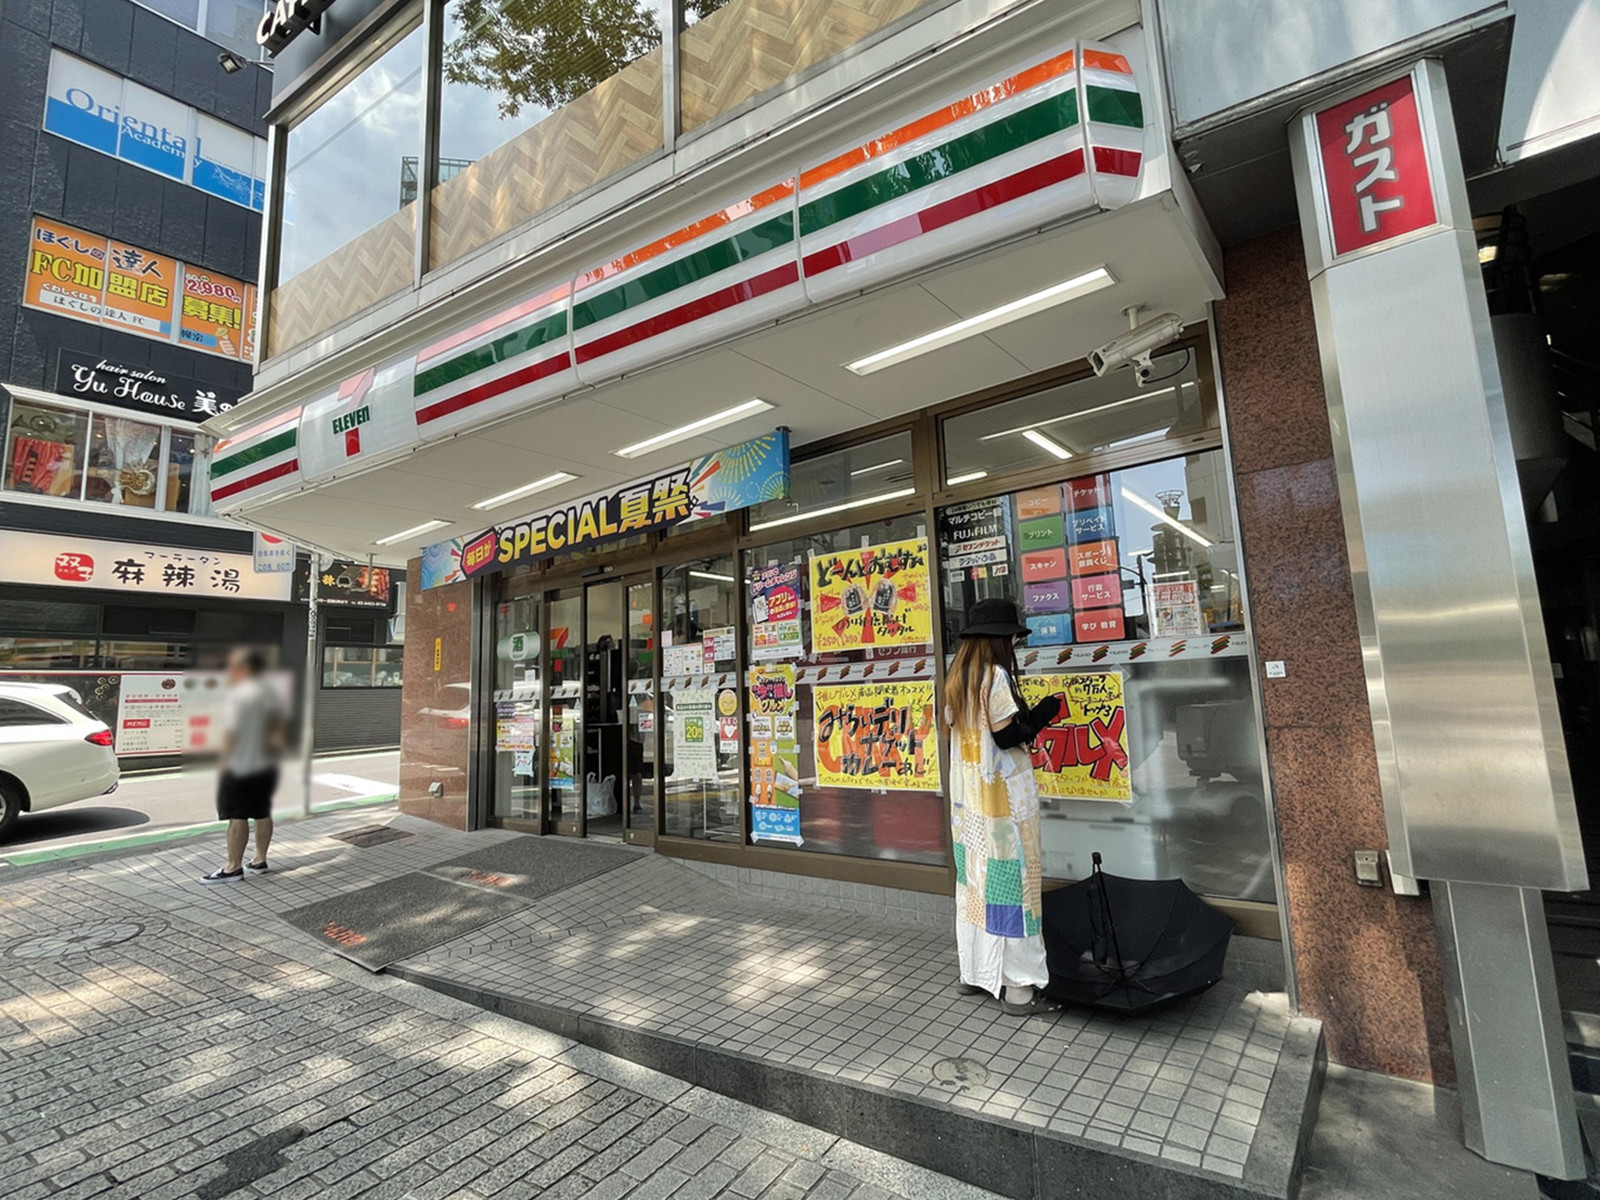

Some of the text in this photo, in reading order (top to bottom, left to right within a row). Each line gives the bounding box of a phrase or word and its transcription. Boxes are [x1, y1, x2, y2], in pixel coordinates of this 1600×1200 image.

[66, 88, 202, 158] Oriental
[121, 124, 203, 168] Academy
[1344, 101, 1402, 233] ガスト
[36, 228, 163, 279] ほぐしの達人
[31, 250, 170, 308] FC加盟店
[53, 295, 146, 326] ほぐしの達人 FC
[95, 359, 168, 385] hair salon
[947, 507, 1002, 526] マルチコピー
[1027, 528, 1054, 540] プリント
[144, 550, 221, 566] マーラータン
[465, 539, 494, 568] 毎日が
[1029, 560, 1058, 571] スキャン
[111, 558, 241, 594] 麻辣湯
[1081, 591, 1112, 601] サービス
